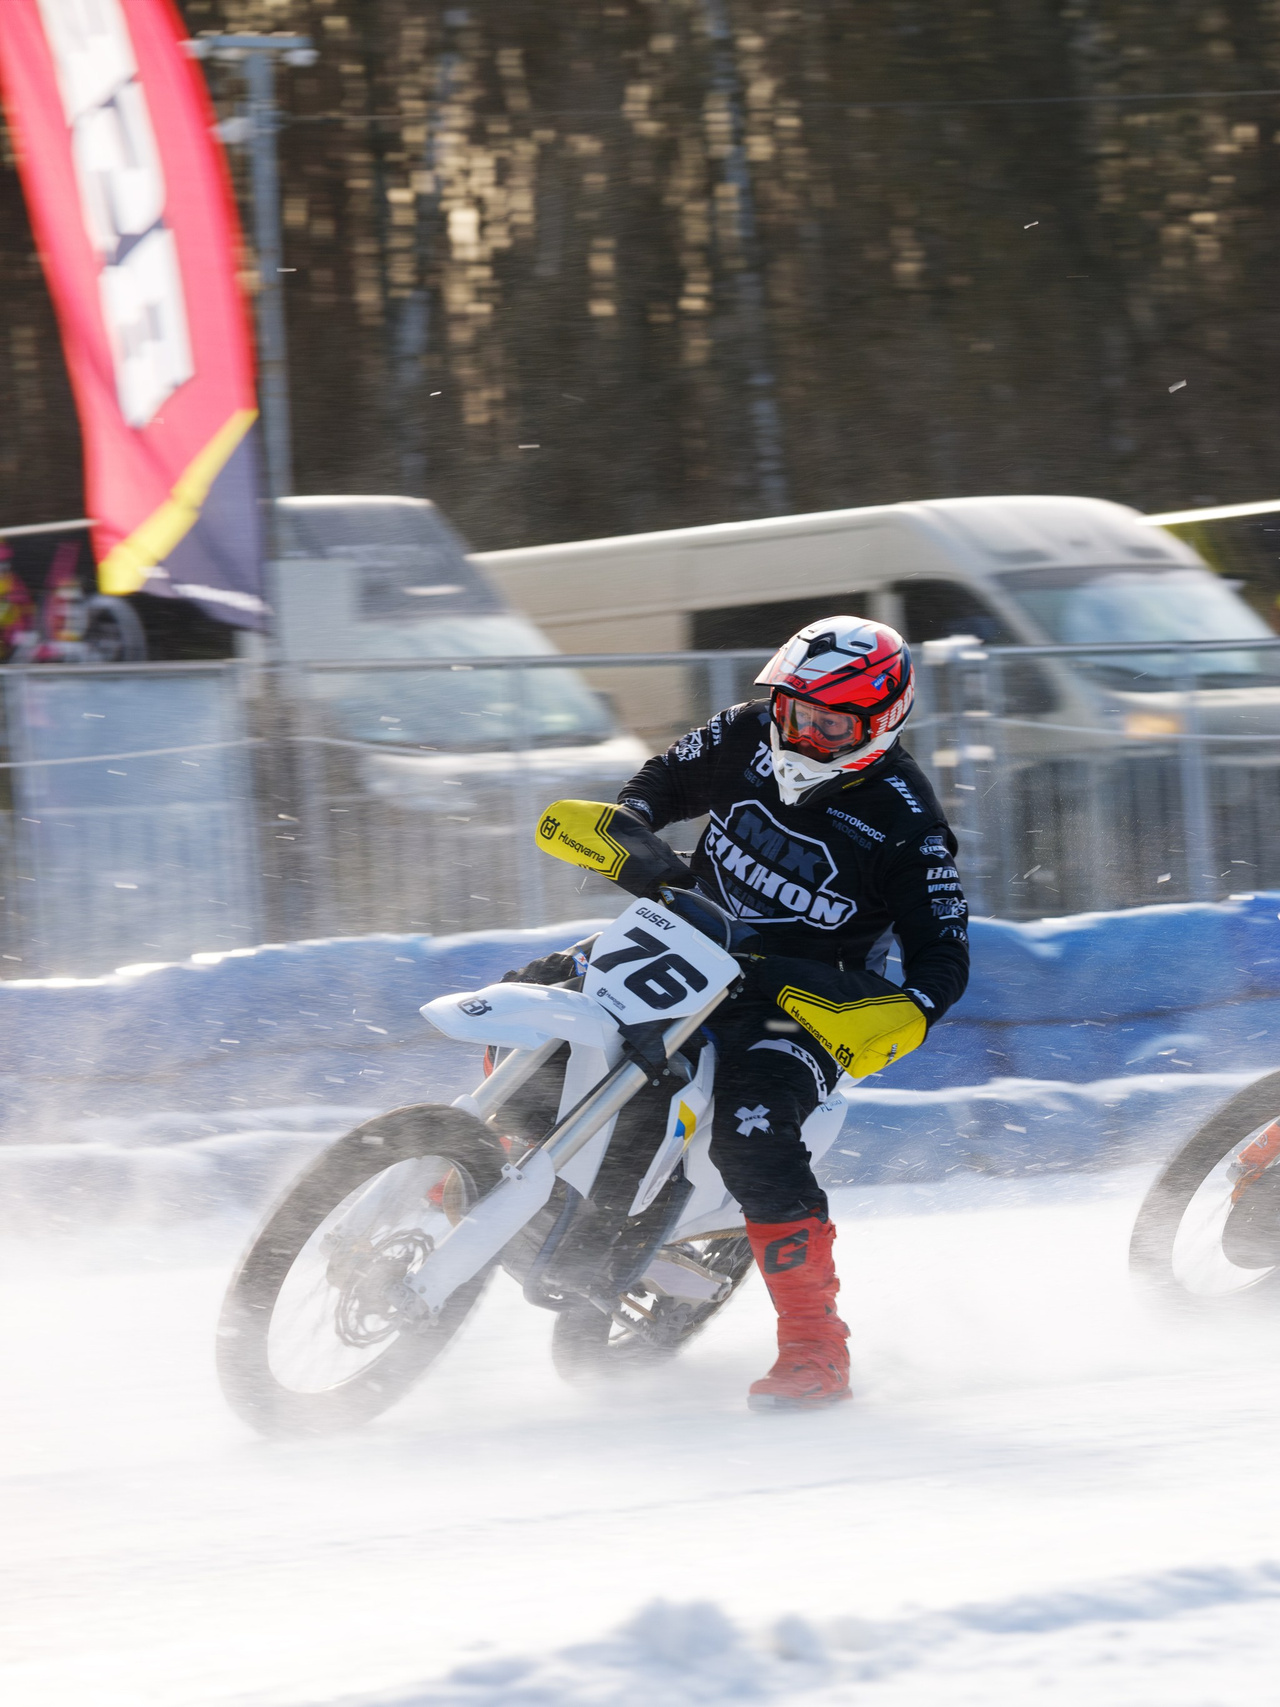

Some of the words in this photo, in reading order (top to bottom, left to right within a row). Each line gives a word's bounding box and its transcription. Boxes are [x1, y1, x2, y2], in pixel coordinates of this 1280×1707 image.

[750, 741, 773, 778] 76
[826, 807, 886, 843] МОТОКРОСС
[832, 820, 873, 850] МОСКВА
[558, 831, 606, 864] Husqvarna
[734, 810, 823, 884] MX
[635, 907, 676, 930] GUSEV
[589, 927, 708, 1011] 76
[791, 1006, 833, 1051] Husqvarna
